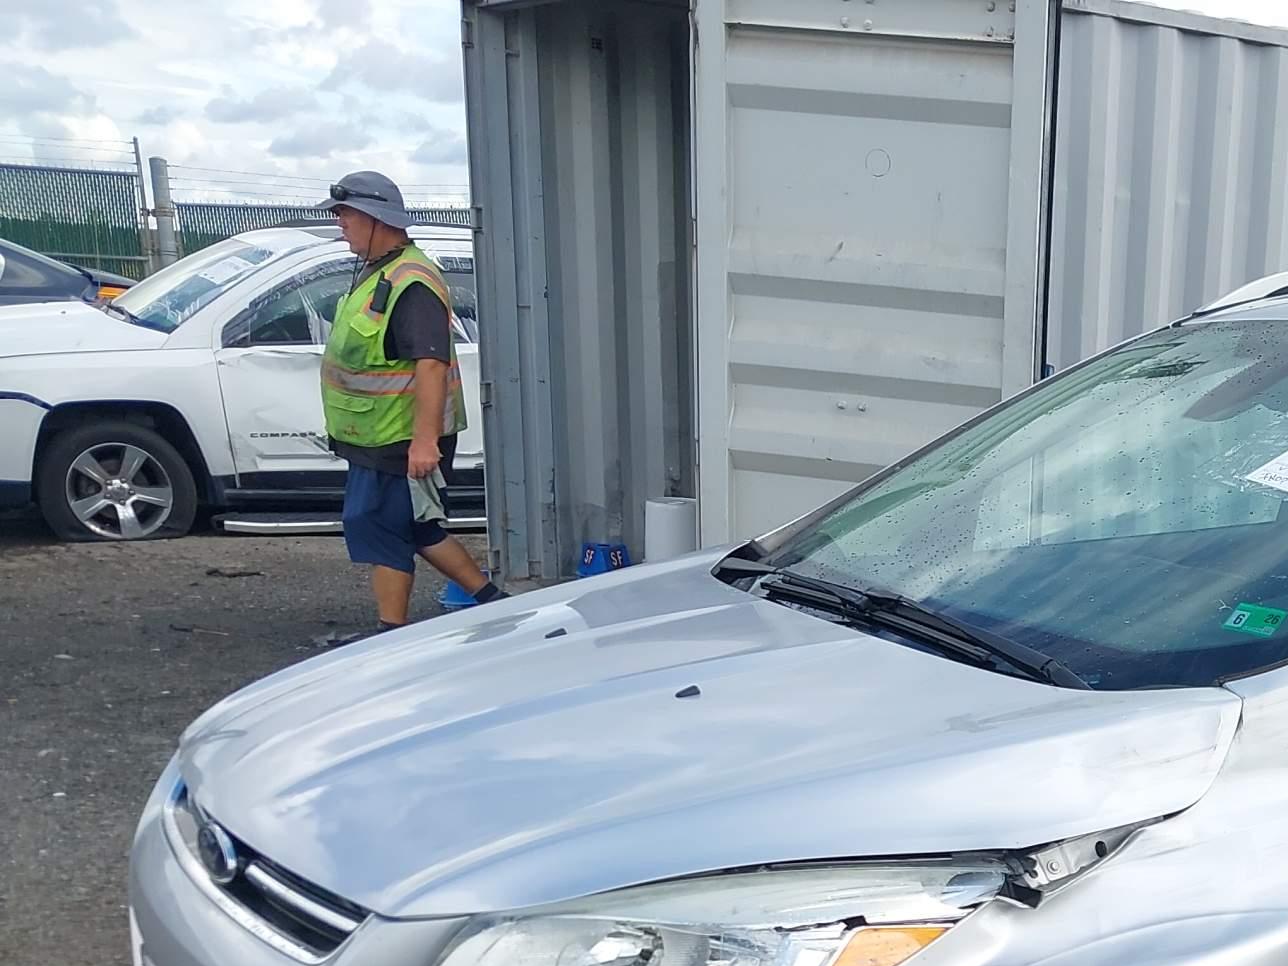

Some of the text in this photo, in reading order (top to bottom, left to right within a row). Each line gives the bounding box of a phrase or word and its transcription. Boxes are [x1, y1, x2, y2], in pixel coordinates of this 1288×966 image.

[584, 549, 594, 565] SF
[610, 550, 622, 567] SF
[1233, 613, 1281, 625] 6 26
